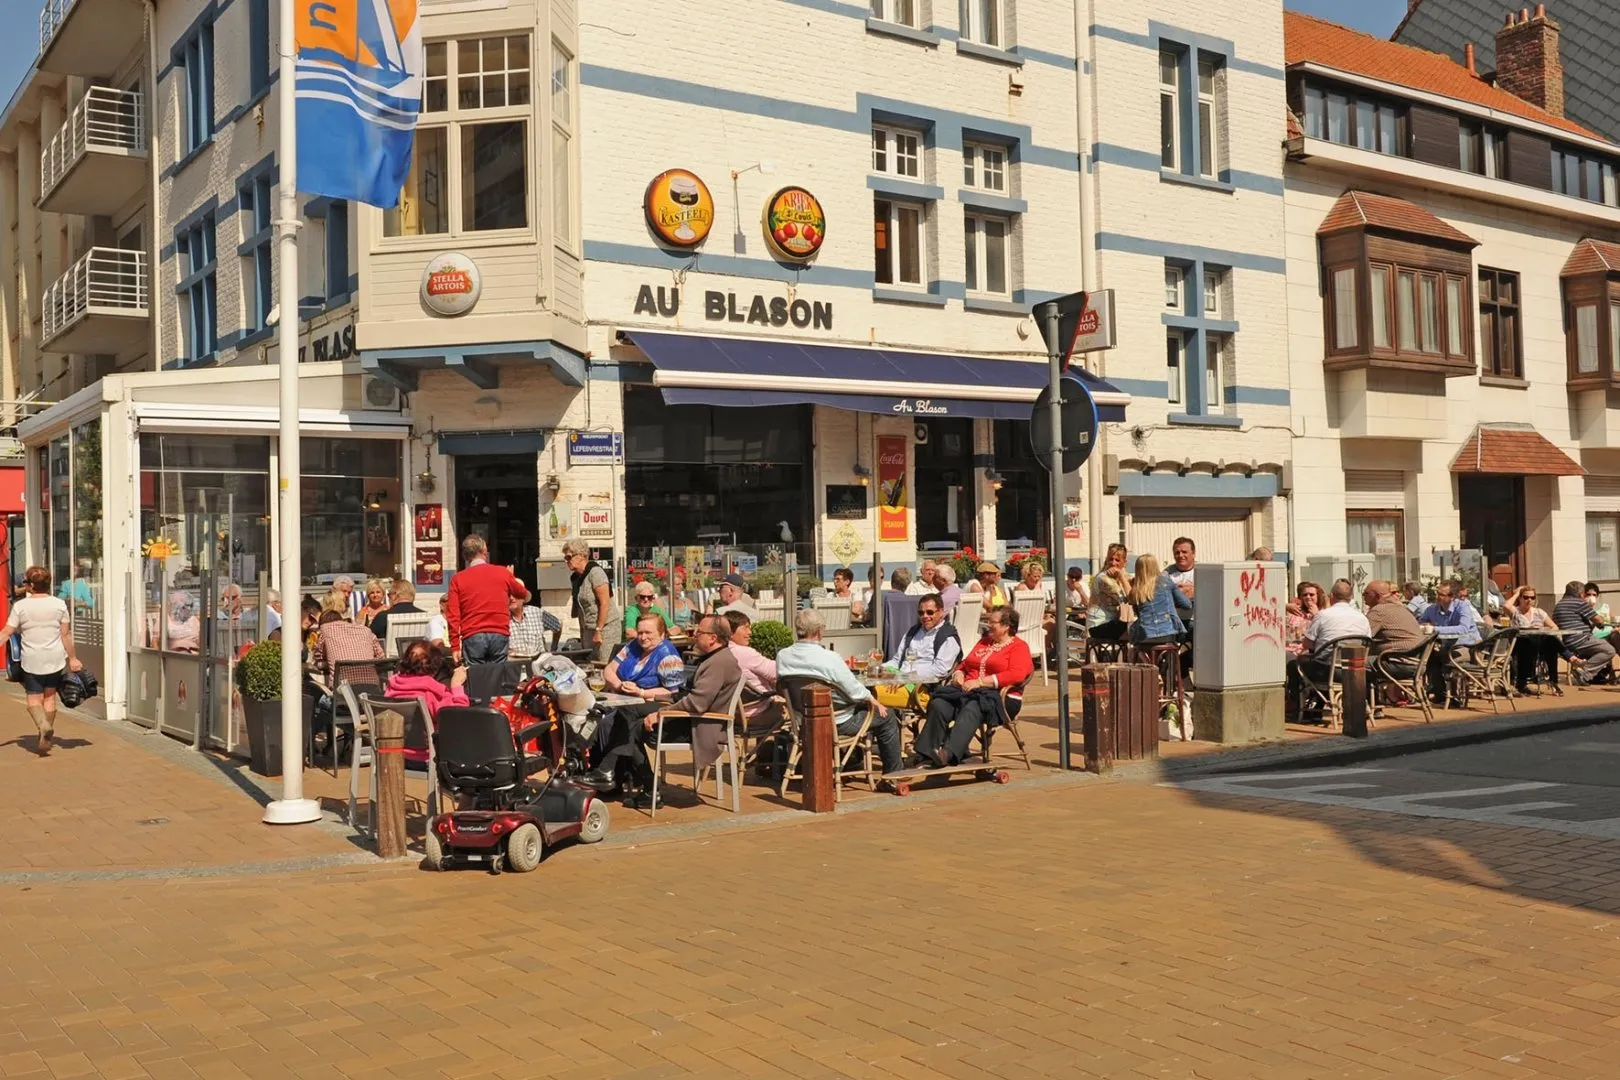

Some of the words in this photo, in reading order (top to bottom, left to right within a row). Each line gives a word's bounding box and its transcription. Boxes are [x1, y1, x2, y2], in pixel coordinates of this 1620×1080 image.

[661, 208, 704, 225] KASTEEL
[432, 274, 465, 284] STELLA
[432, 281, 466, 291] ARTOIS
[633, 284, 680, 318] AU
[705, 290, 833, 331] BLASON
[892, 399, 914, 413] Au
[914, 399, 949, 414] Blason
[583, 511, 609, 524] Duvel
